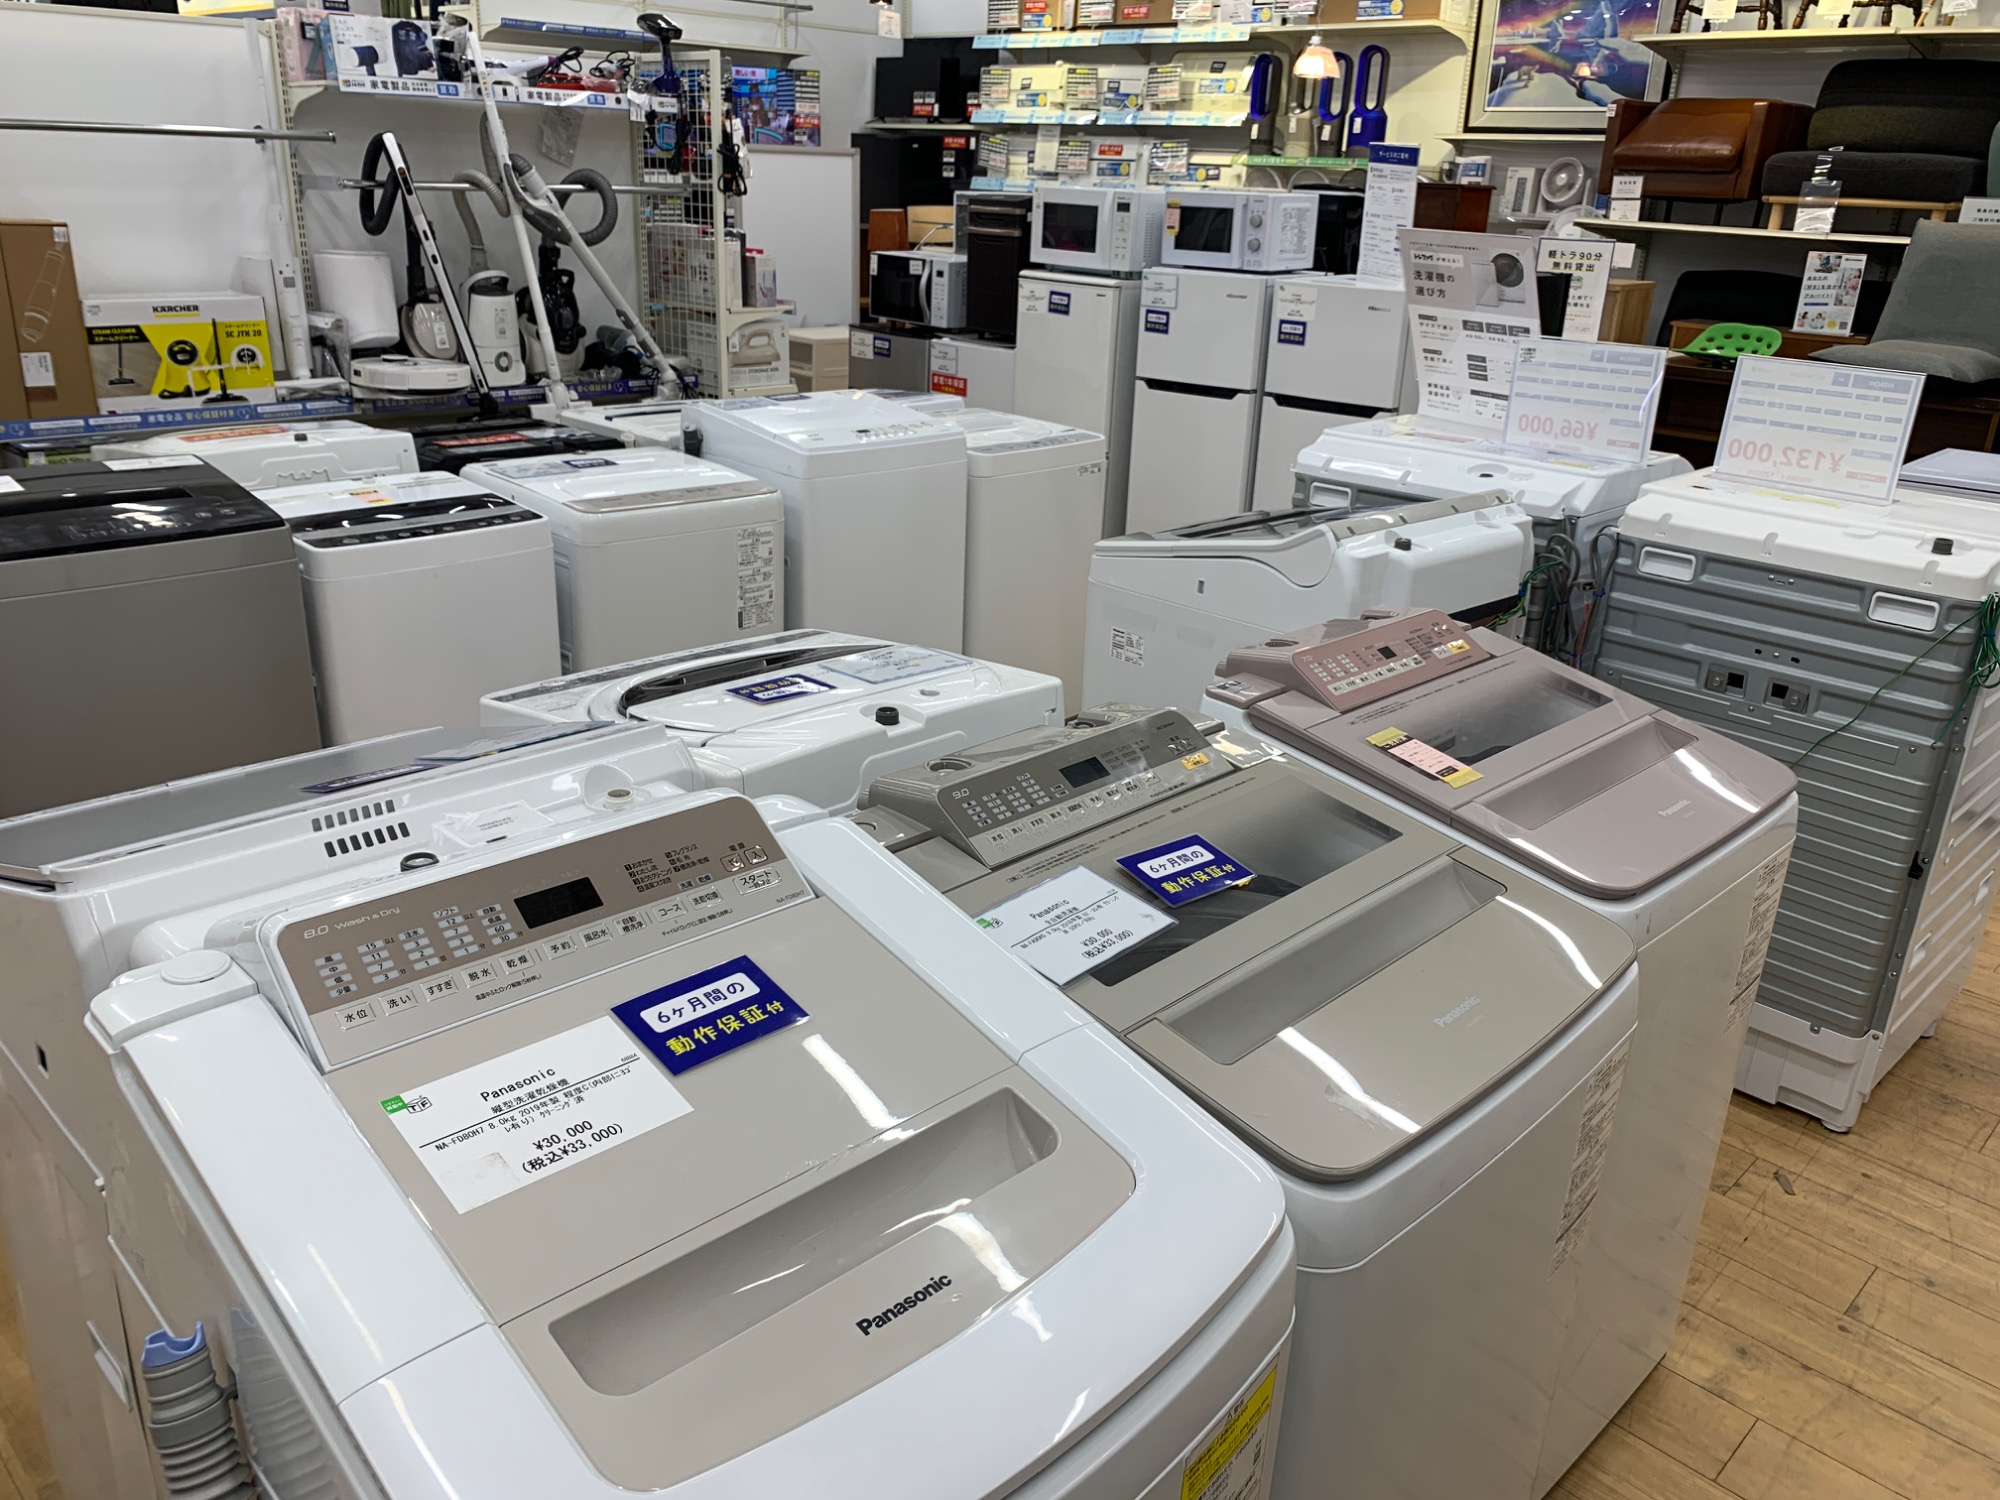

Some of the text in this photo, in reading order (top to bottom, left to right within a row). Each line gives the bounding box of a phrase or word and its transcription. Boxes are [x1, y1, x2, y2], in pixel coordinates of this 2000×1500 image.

[369, 79, 411, 92] 家電製品
[1547, 249, 1603, 262] 軽トラ90分
[1552, 261, 1595, 272] 無料貸出
[1413, 269, 1455, 283] 洗濯機の
[1415, 286, 1446, 299] 選び方
[225, 330, 235, 339] SC
[252, 329, 262, 337] 20
[952, 787, 970, 800] 9.0
[728, 842, 745, 852] 電源
[752, 851, 762, 859] 入
[624, 857, 654, 871] 1 おまかせ
[740, 869, 772, 886] スタート
[1160, 863, 1236, 894] 動作保証付
[436, 908, 456, 917] ソフト
[482, 906, 497, 915] 自動
[657, 903, 682, 917] コース
[1029, 899, 1070, 920] Panasonic
[304, 925, 329, 940] 8.0
[334, 915, 371, 929] Wash
[379, 907, 400, 917] Dry
[446, 918, 456, 926] 12
[621, 915, 637, 926] 自動
[622, 920, 645, 933] 槽洗浄
[404, 929, 420, 939] 注水
[494, 925, 505, 933] 60
[583, 928, 609, 943] 風呂水
[499, 935, 510, 943] 30
[1080, 928, 1113, 947] ¥30,000
[1081, 929, 1134, 959] (税込¥33,000)
[365, 942, 377, 951] 15
[550, 941, 571, 954] 予約
[371, 952, 382, 960] 11
[506, 954, 529, 968] 乾燥
[468, 967, 492, 981] 脱水
[425, 979, 453, 996] すすぎ
[386, 994, 412, 1009] 洗い
[344, 1008, 369, 1023] 水位
[1432, 996, 1481, 1027] Panasonic
[665, 1000, 785, 1056] 動作保証付
[480, 1068, 556, 1102] Panasonic
[490, 1077, 571, 1114] 縦型洗濯乾燥機
[434, 1126, 485, 1152] NA-FD80H7
[488, 1115, 517, 1130] 8.0kg
[518, 1095, 560, 1118] 2019年製
[532, 1120, 594, 1151] ¥30,000
[522, 1122, 624, 1174] (税込¥33,000)
[855, 1275, 952, 1337] Panasonic
